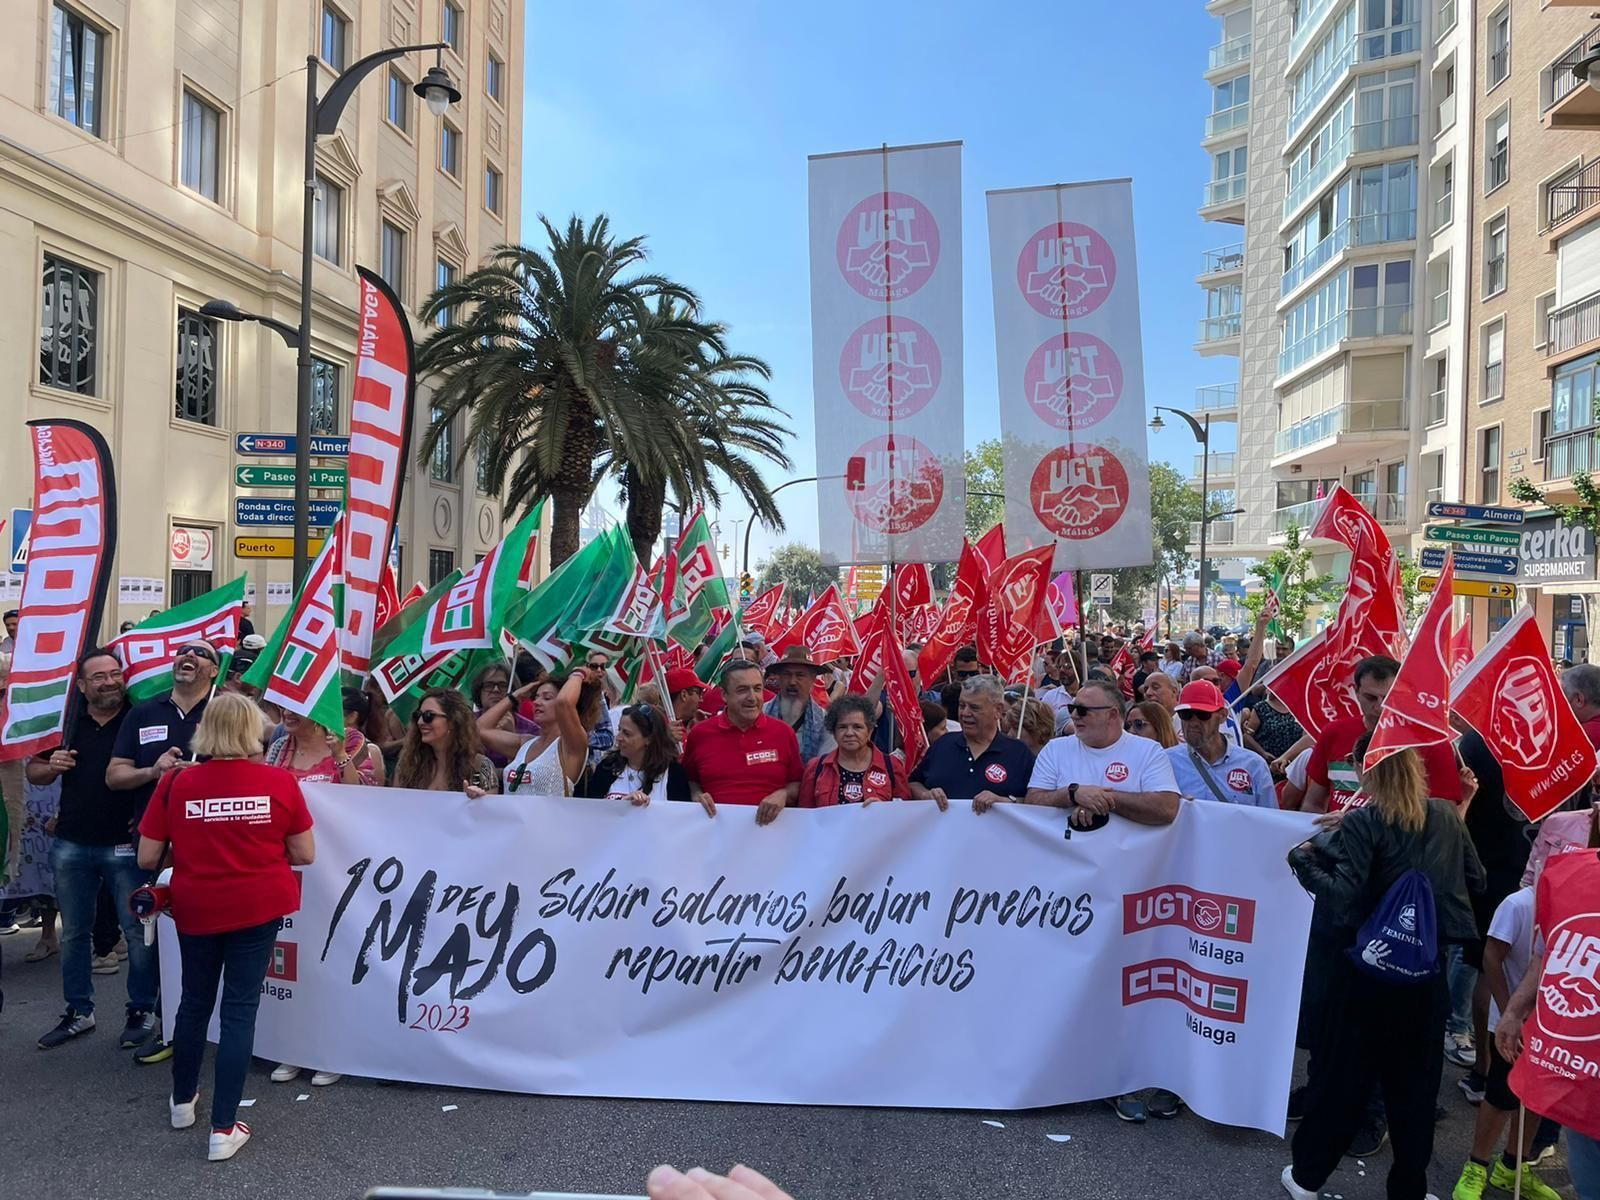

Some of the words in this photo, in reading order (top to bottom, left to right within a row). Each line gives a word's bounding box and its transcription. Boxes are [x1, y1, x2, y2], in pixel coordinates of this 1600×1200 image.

[857, 207, 917, 247] UGT
[1037, 236, 1091, 269] UGT
[859, 331, 918, 368] UGT
[1044, 346, 1099, 382] UGT
[256, 440, 284, 448] N-340
[263, 472, 296, 482] Paseo
[1050, 456, 1104, 489] UGT
[238, 502, 271, 511] Rondas
[238, 512, 265, 521] Todas
[1483, 509, 1522, 520] Almería
[238, 542, 276, 552] Puerto
[1060, 525, 1101, 537] Málaga
[1446, 530, 1470, 540] Paseo
[1473, 532, 1486, 541] del
[1489, 535, 1519, 544] Parque
[1524, 561, 1586, 577] SUPERMARKET
[1528, 749, 1585, 799] www.ugt.es
[208, 801, 256, 812] CCOO
[436, 884, 484, 917] DE
[538, 867, 650, 923] Subir
[822, 875, 931, 936] bajar
[944, 885, 1095, 939] precios
[1135, 892, 1192, 925] UGT
[352, 869, 557, 1024] MAYO
[604, 932, 781, 994] repartir
[773, 936, 976, 994] beneficios
[1188, 936, 1244, 965] Málaga
[1547, 929, 1600, 975] UG
[1129, 966, 1210, 1008] CCOO
[408, 1002, 471, 1033] 2023
[1186, 1012, 1236, 1045] Málaga
[1550, 1046, 1600, 1078] man
